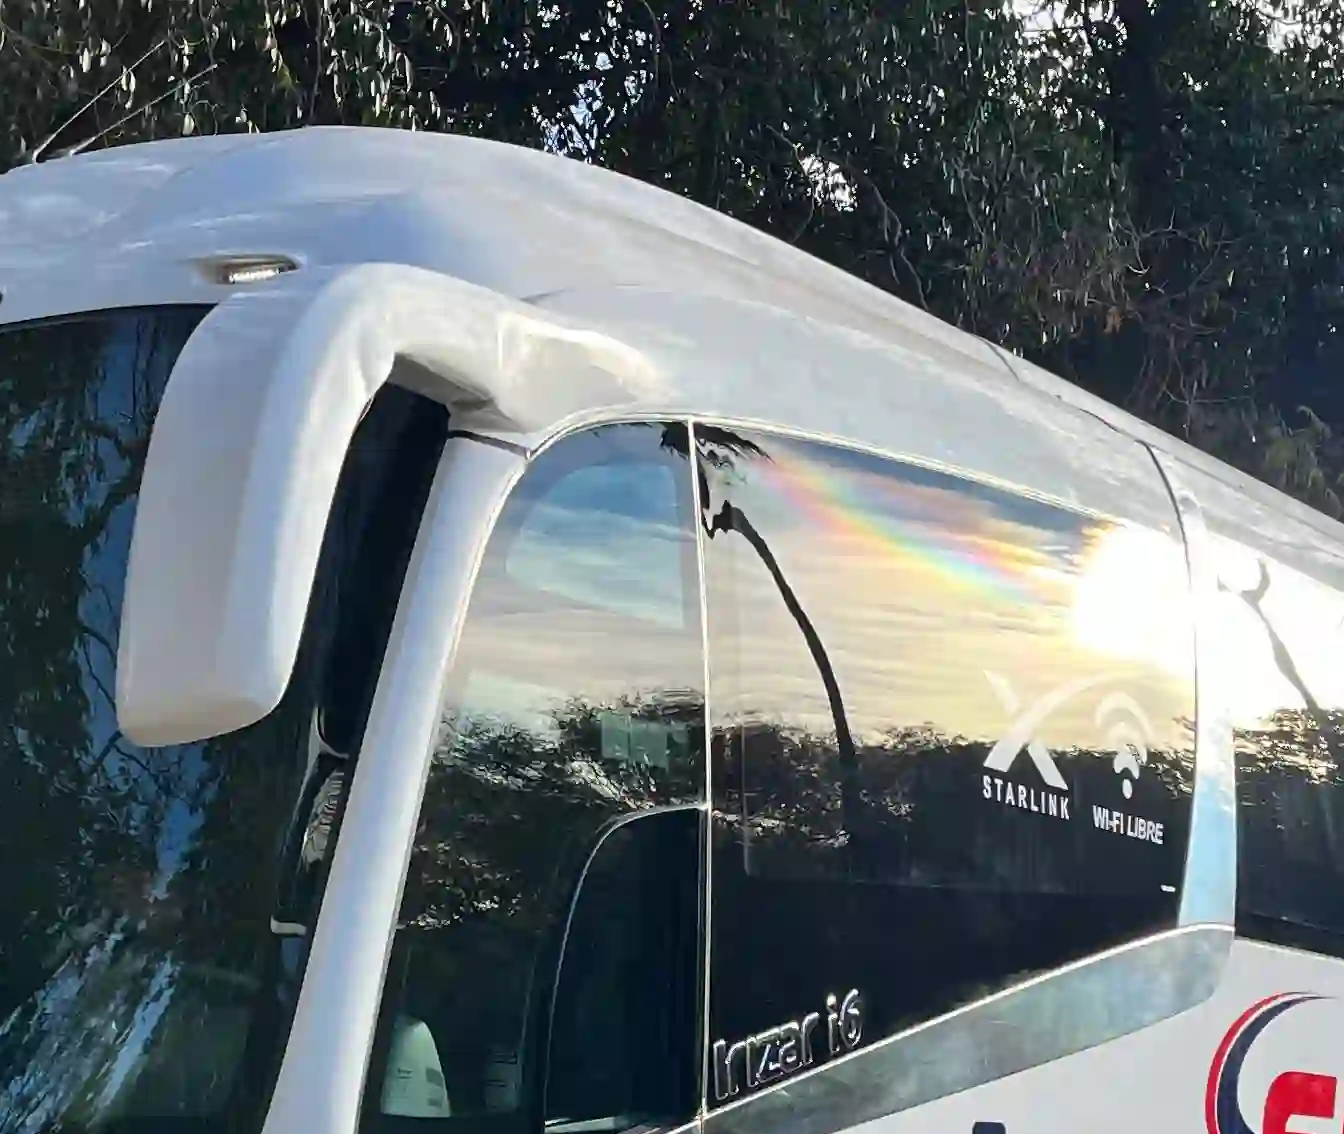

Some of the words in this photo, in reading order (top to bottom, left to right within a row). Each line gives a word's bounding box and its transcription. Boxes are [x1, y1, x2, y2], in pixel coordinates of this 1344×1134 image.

[982, 775, 1070, 820] STARLINK
[1092, 804, 1125, 835] WI-FI
[1126, 815, 1164, 844] LIBRE
[713, 1011, 820, 1100] Irizar
[826, 987, 864, 1056] i6
